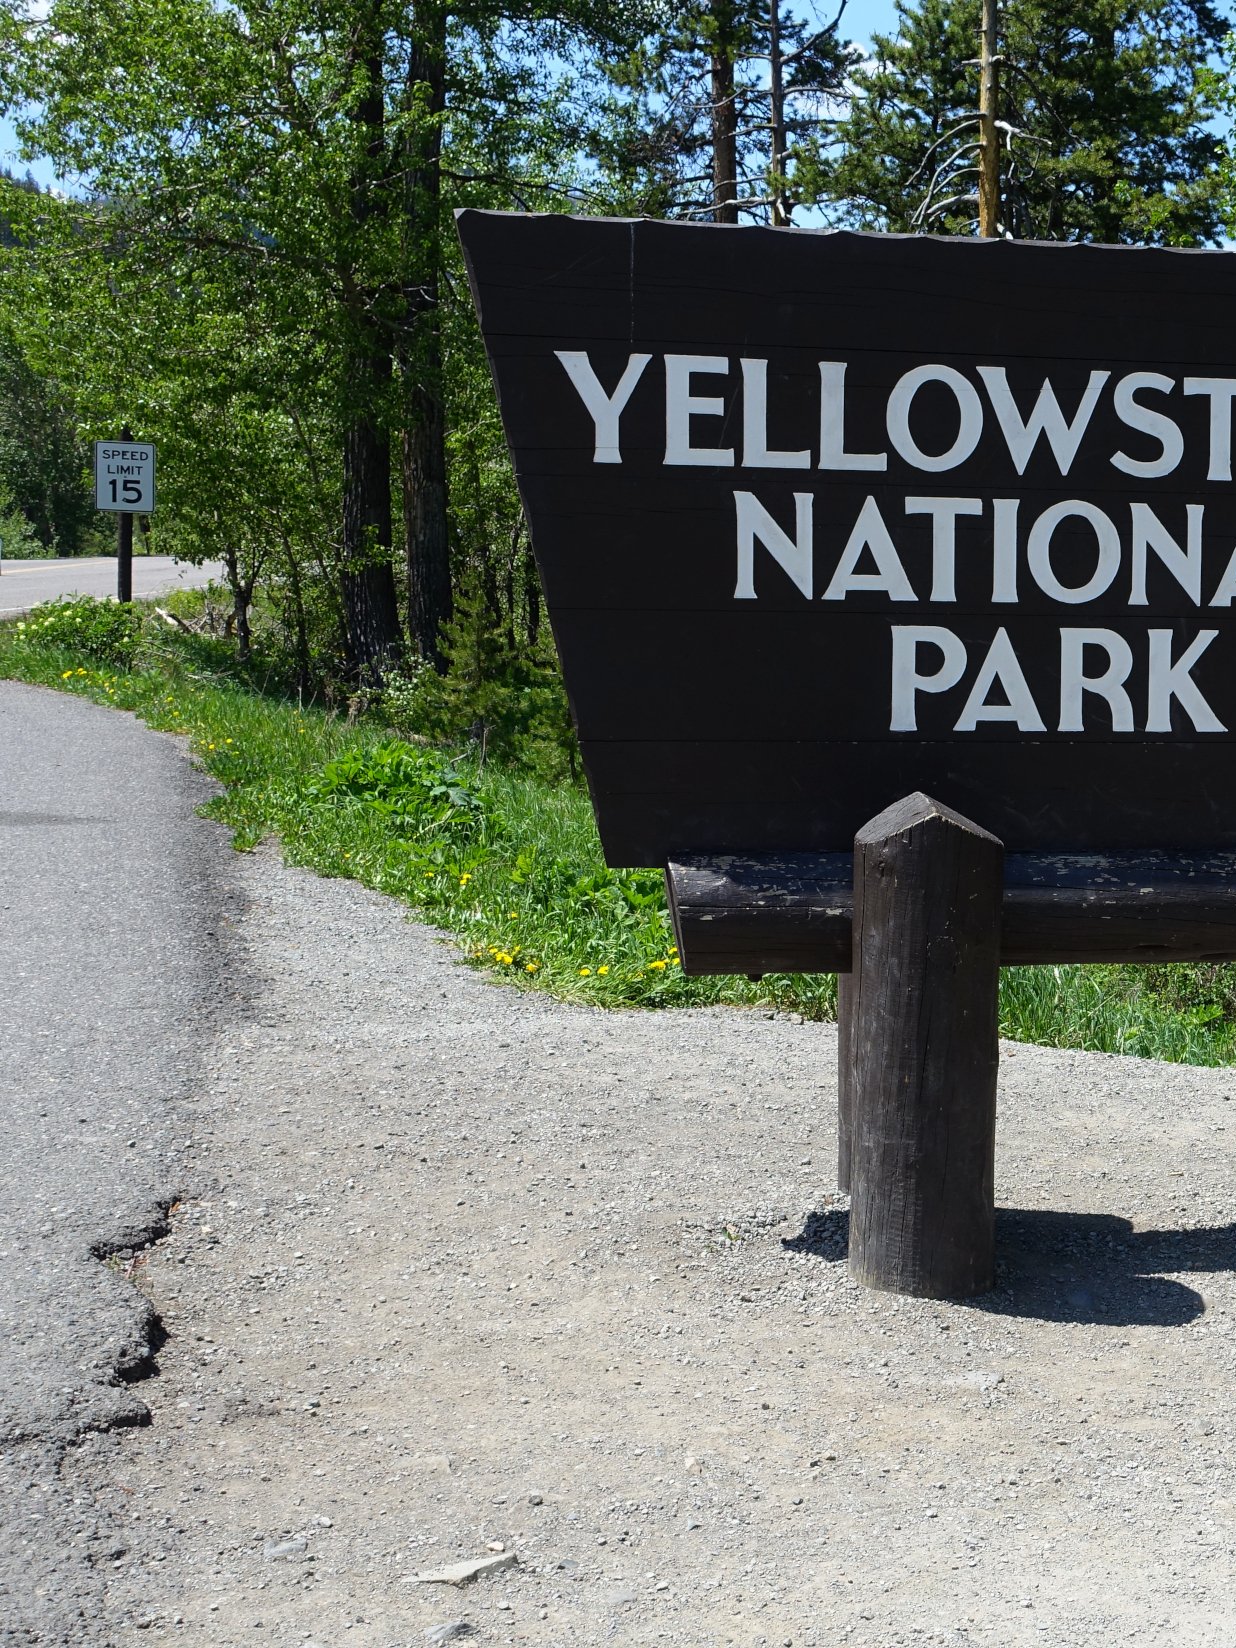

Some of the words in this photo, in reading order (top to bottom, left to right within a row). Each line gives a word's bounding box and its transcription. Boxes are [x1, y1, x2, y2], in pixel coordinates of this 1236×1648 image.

[102, 449, 149, 461] SPEED
[107, 464, 143, 475] LIMIT
[108, 478, 143, 504] 15
[889, 625, 1228, 733] PARK
